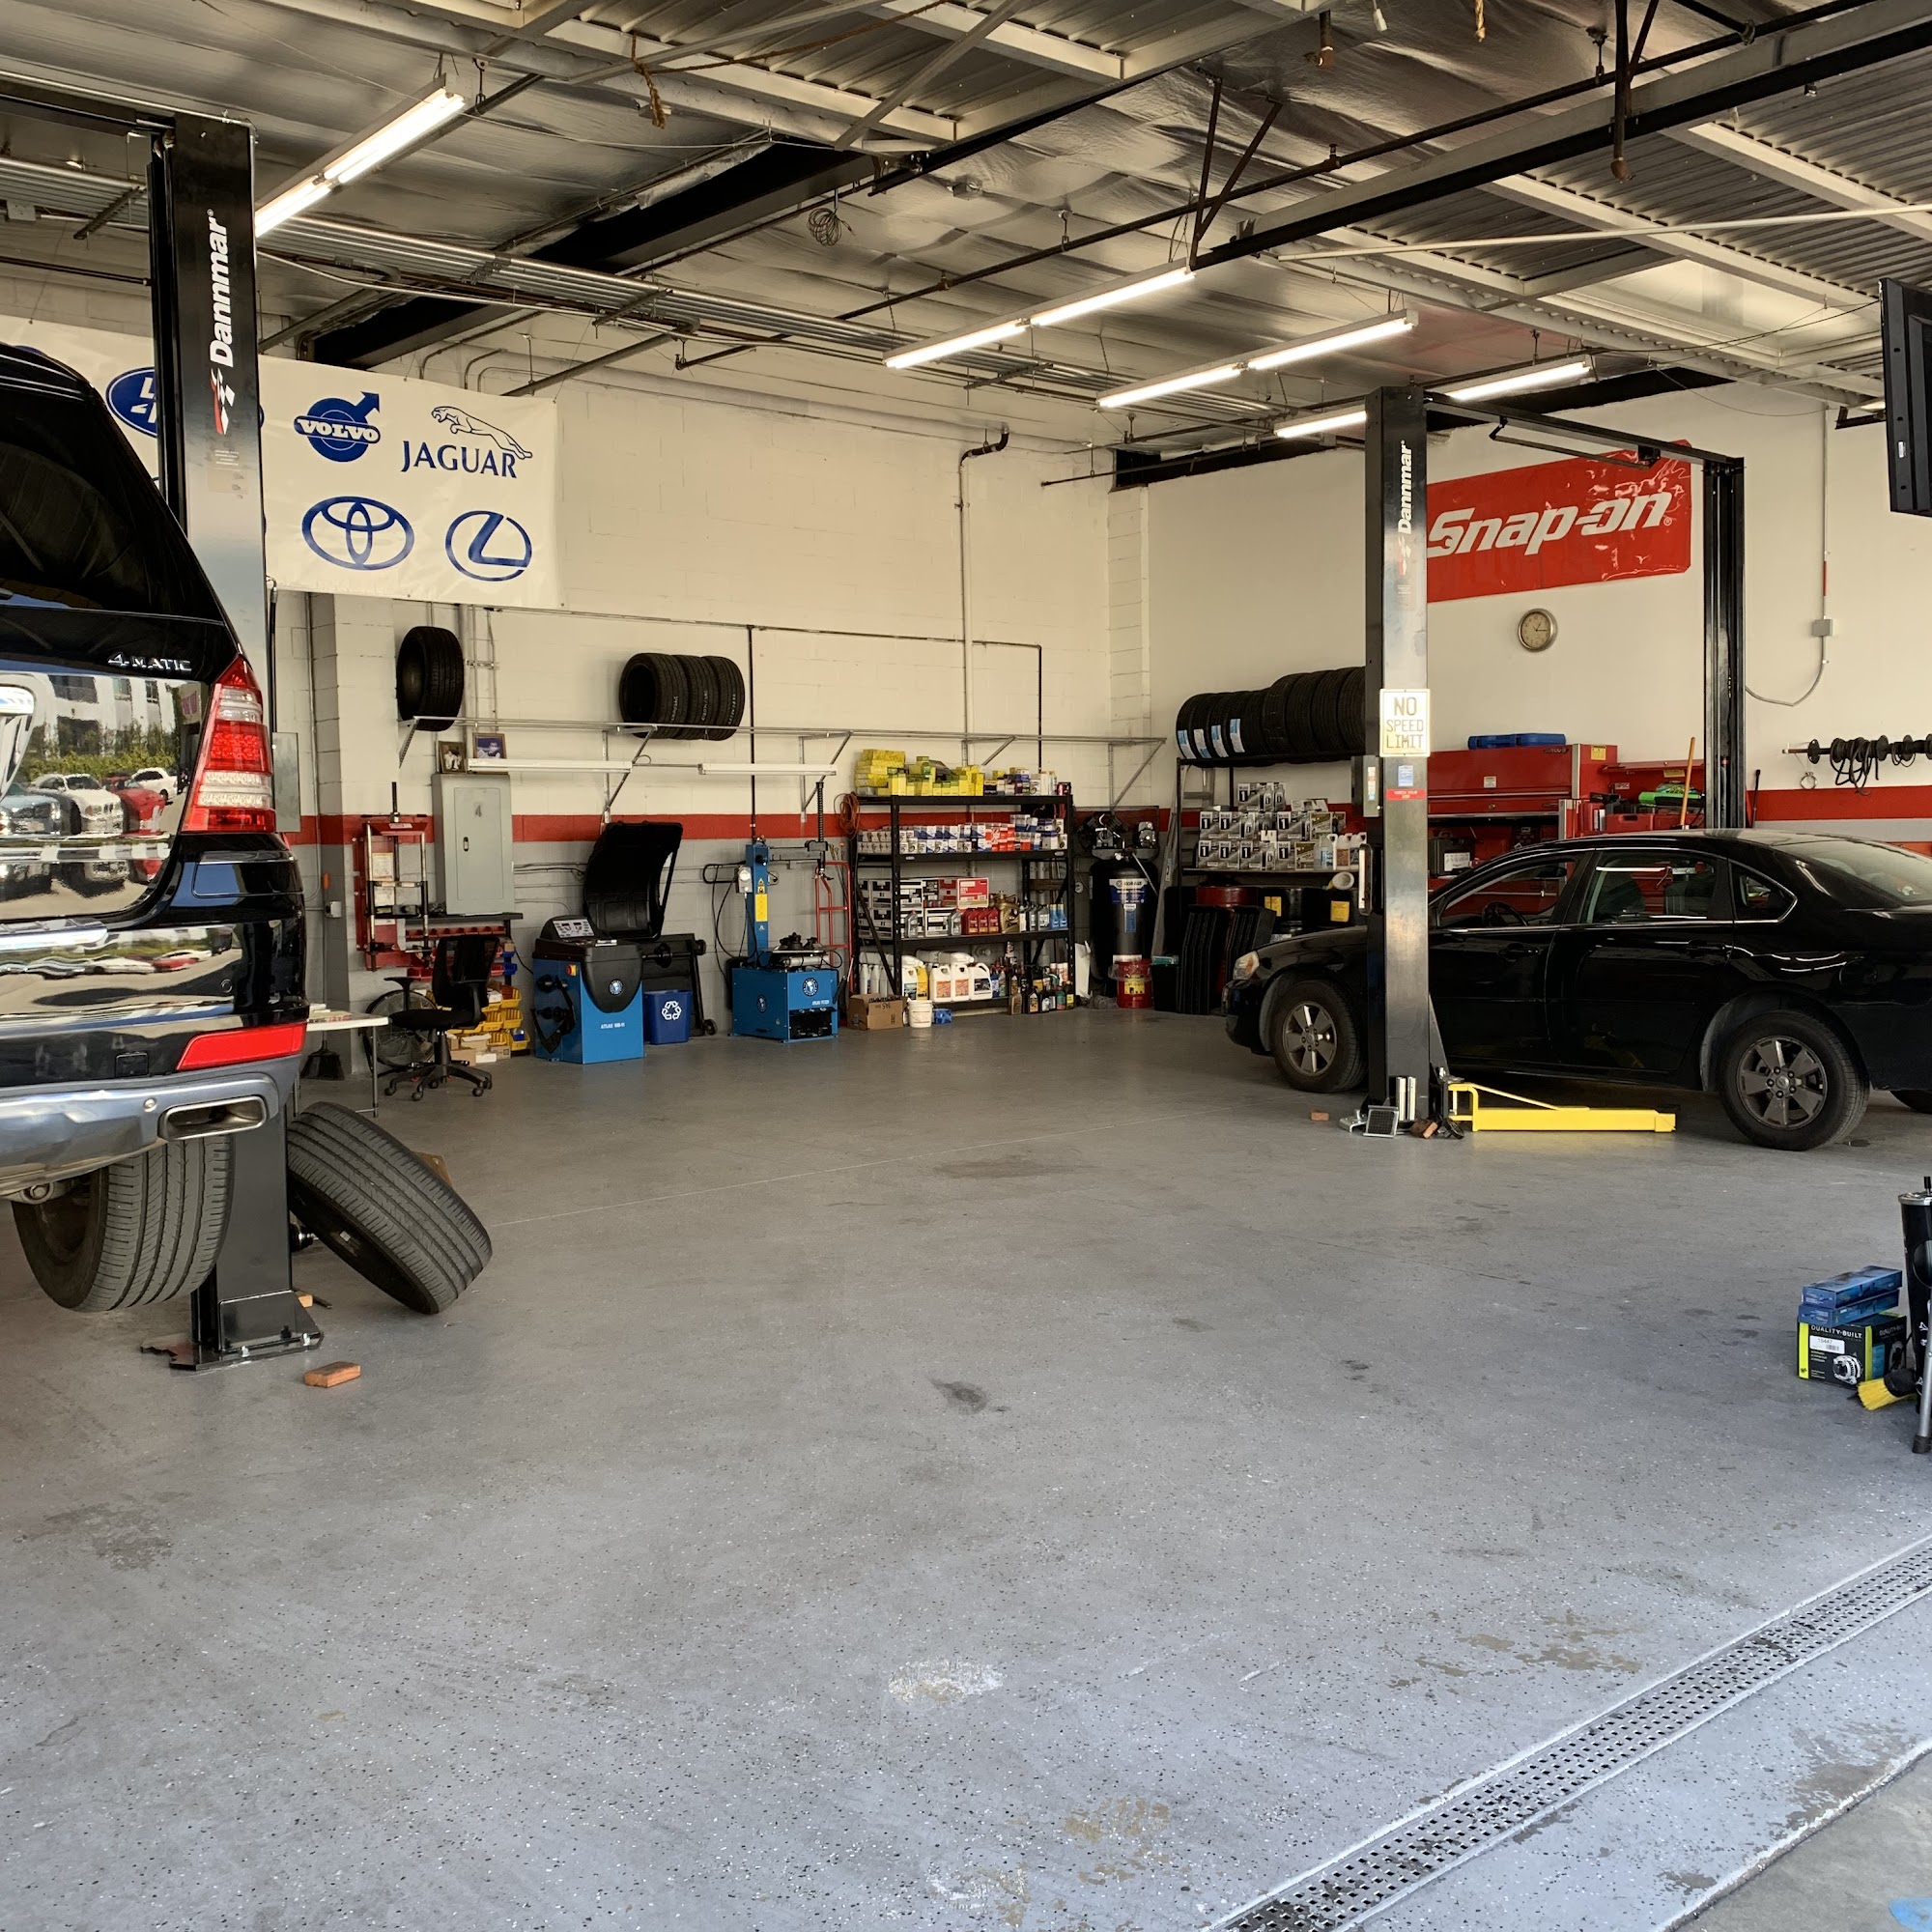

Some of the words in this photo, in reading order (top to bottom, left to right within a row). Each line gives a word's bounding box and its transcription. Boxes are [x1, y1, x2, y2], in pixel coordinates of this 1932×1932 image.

[209, 215, 234, 368] Dannmar
[297, 417, 380, 443] VOLVO
[400, 440, 518, 479] JAGUAR
[1397, 444, 1412, 535] Dannmar
[1427, 491, 1673, 558] Snap-on
[1393, 696, 1417, 716] NO
[1385, 719, 1424, 732] SPEED
[1386, 734, 1424, 749] LIMIT
[474, 804, 482, 817] 4
